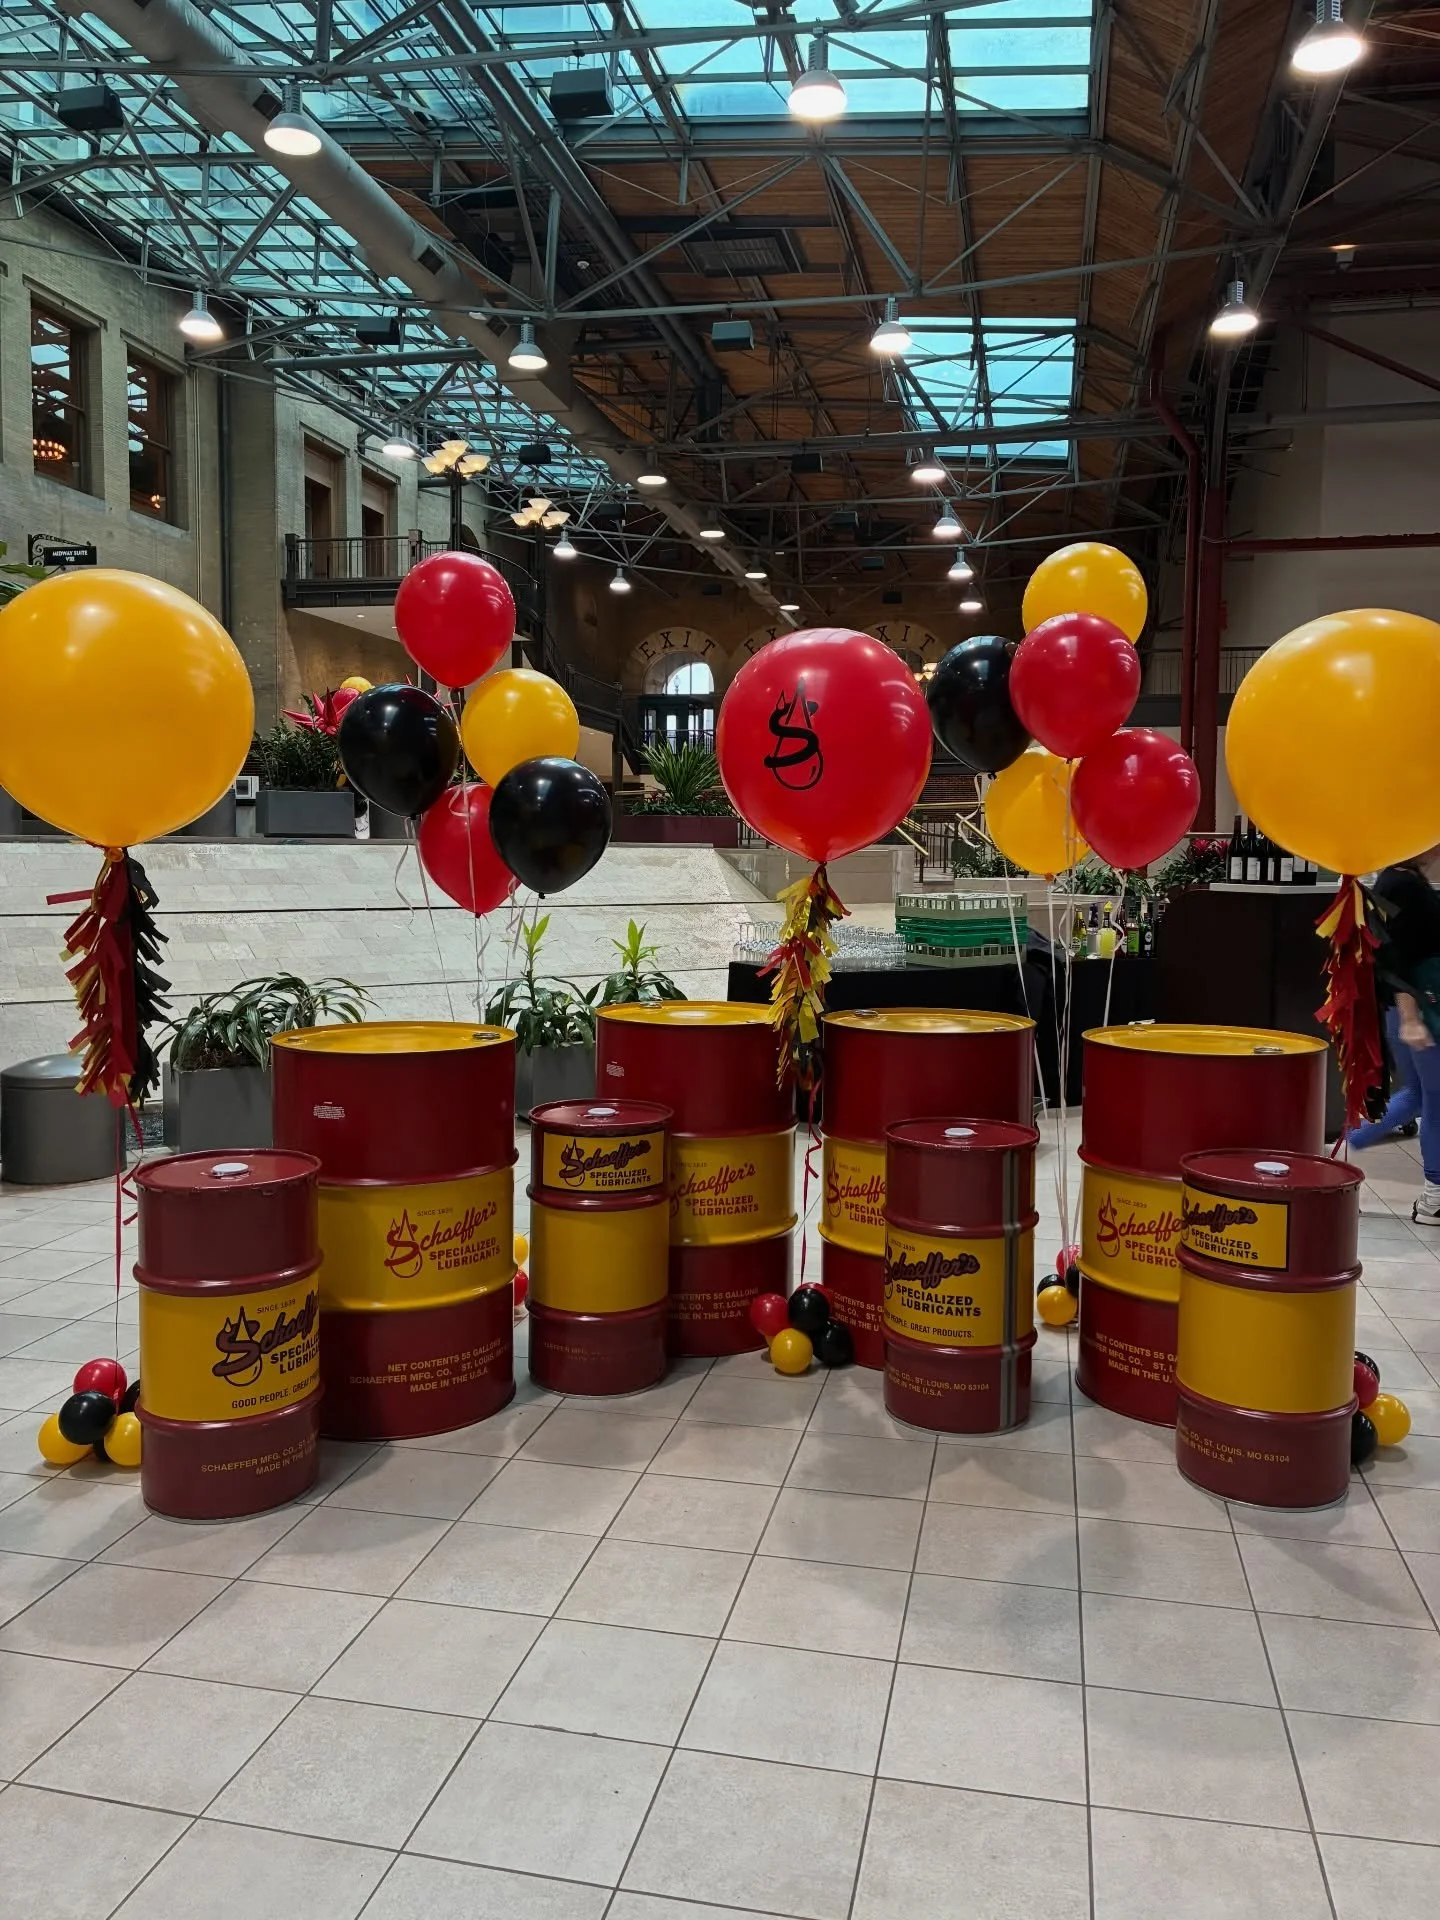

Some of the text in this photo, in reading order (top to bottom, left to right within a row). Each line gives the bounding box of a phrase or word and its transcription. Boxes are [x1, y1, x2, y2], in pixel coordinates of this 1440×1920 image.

[639, 631, 716, 660] EXIT
[744, 628, 777, 655] EX
[876, 625, 936, 651] XIT
[559, 1140, 651, 1179] Schaeffer's
[590, 1168, 647, 1179] SPECIALIZED
[596, 1176, 652, 1187] LUBRICANTS
[826, 1172, 886, 1204] Schaeffe
[685, 1195, 754, 1207] SPECIALIZED
[692, 1203, 759, 1216] LUBRICANTS
[845, 1201, 882, 1216] SPECIAL
[849, 1212, 885, 1226] LUBRIC
[1097, 1208, 1181, 1243] Schaeffe
[384, 1201, 497, 1267] Schaeffer's
[1191, 1228, 1252, 1250] SPECIALIZED
[429, 1237, 496, 1260] SPECIALIZED
[437, 1245, 500, 1271] LUBRICANTS
[1125, 1240, 1174, 1257] SPECIAL
[1195, 1239, 1259, 1260] LUBRICANTS
[1131, 1251, 1177, 1268] LUBRIC
[896, 1283, 973, 1306] SPECIALIZED
[257, 1304, 279, 1314] SINCE
[692, 1312, 701, 1320] IN
[703, 1312, 719, 1320] THE
[722, 1309, 744, 1319] U.S.A.
[901, 1297, 982, 1317] LUBRICANTS
[212, 1289, 319, 1378] Schaeff
[858, 1320, 872, 1330] THE
[910, 1323, 931, 1334] GREAT
[932, 1327, 974, 1338] PRODUCTS.
[270, 1332, 319, 1365] SPECIALI
[1109, 1338, 1151, 1357] CONTENTS
[1153, 1351, 1164, 1360] 55
[279, 1346, 319, 1375] LUBRIC
[387, 1363, 407, 1372] NET
[410, 1354, 460, 1371] CONTENTS
[461, 1351, 471, 1361] 55
[1108, 1359, 1130, 1374] MADE
[1131, 1367, 1140, 1377] IN
[1142, 1370, 1161, 1381] THE
[1128, 1355, 1143, 1367] CO.
[1153, 1362, 1167, 1372] ST.
[350, 1375, 407, 1384] SCHAEFFER
[410, 1370, 434, 1382] MFG.
[436, 1367, 452, 1378] CO.
[461, 1362, 473, 1372] ST.
[410, 1380, 438, 1393] MADE
[440, 1378, 449, 1388] IN
[452, 1373, 468, 1385] THE
[908, 1383, 921, 1393] THE
[953, 1383, 966, 1391] MO
[231, 1397, 257, 1409] GOOD
[259, 1389, 290, 1404] PEOPLE.
[1197, 1444, 1211, 1456] THE
[1247, 1451, 1261, 1461] MO
[1264, 1454, 1290, 1463] 63104
[200, 1458, 258, 1473] SCHAEFFER
[260, 1452, 280, 1464] MFG.
[256, 1461, 280, 1475] MADE
[282, 1459, 290, 1467] IN
